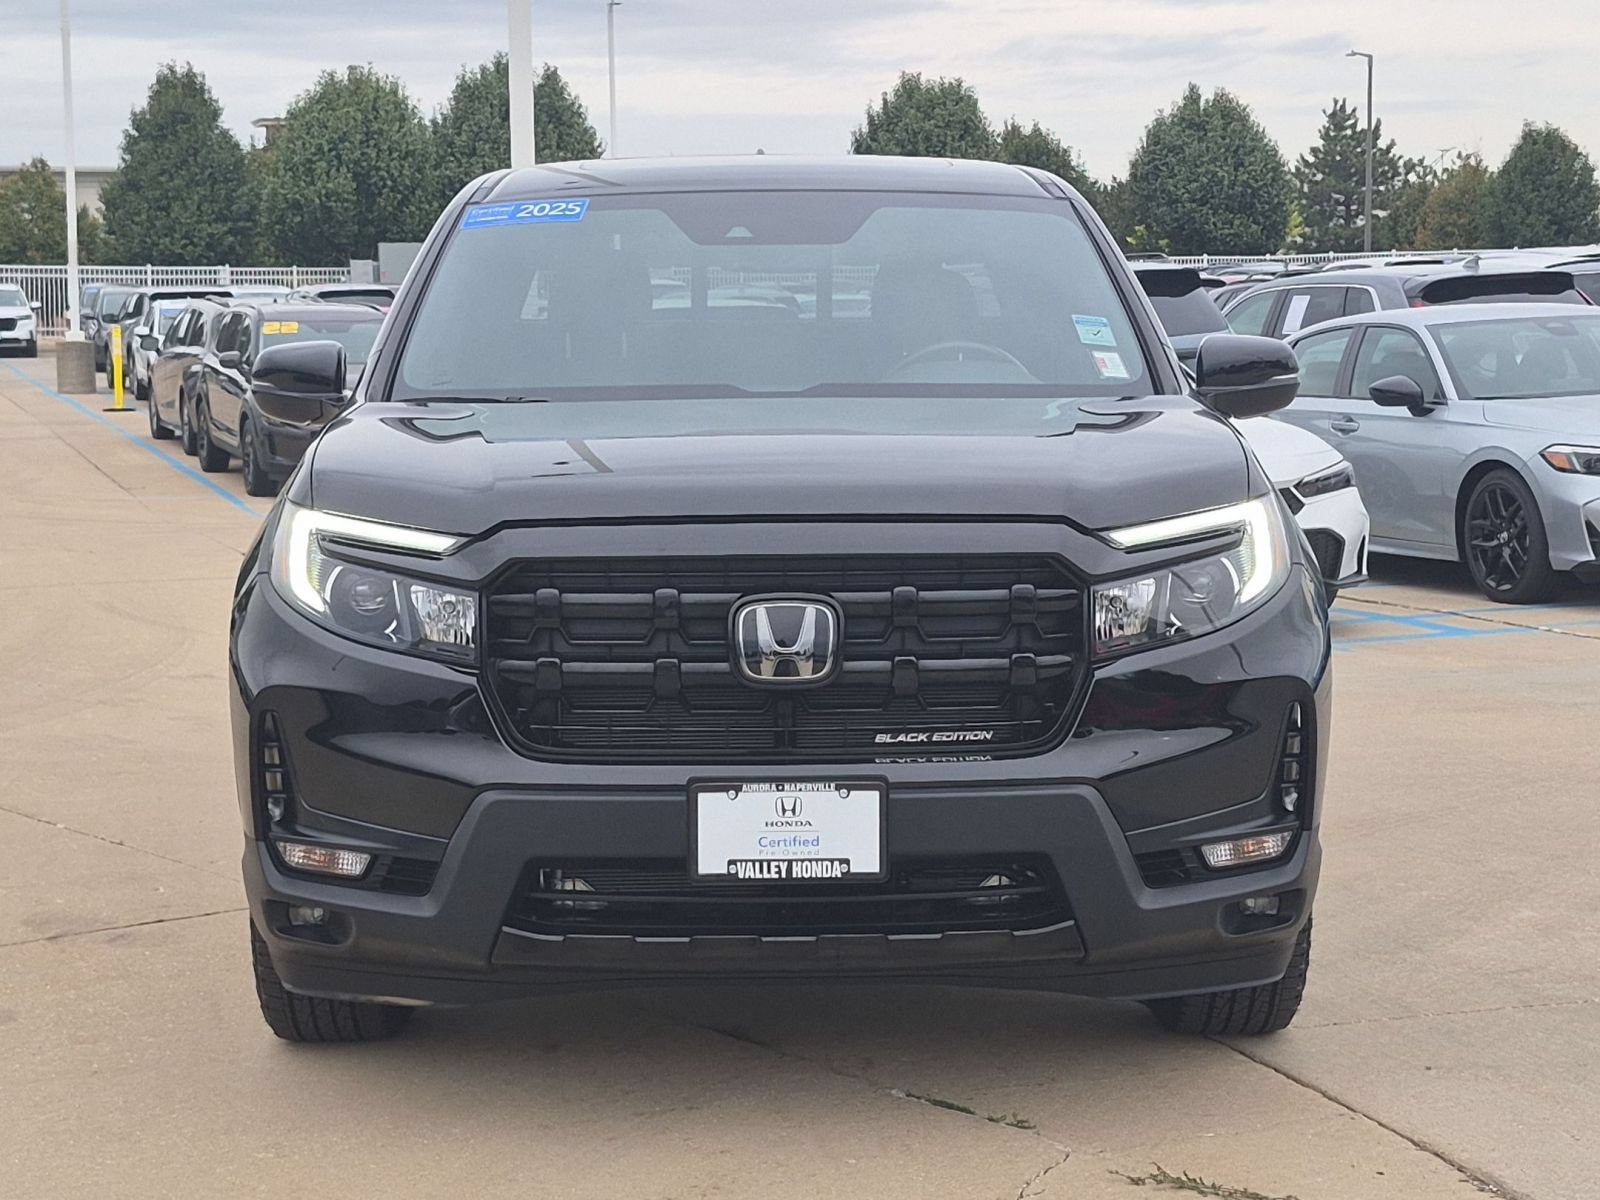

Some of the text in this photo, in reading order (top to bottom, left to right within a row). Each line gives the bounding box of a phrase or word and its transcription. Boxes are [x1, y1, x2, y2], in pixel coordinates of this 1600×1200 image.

[516, 202, 582, 217] 2025
[874, 730, 993, 743] BLACK EDITION
[741, 782, 836, 792] AURORA NAPERVILLE
[765, 820, 812, 828] HONDA
[758, 836, 820, 848] Certified
[736, 861, 842, 879] VALLEY HONDA
